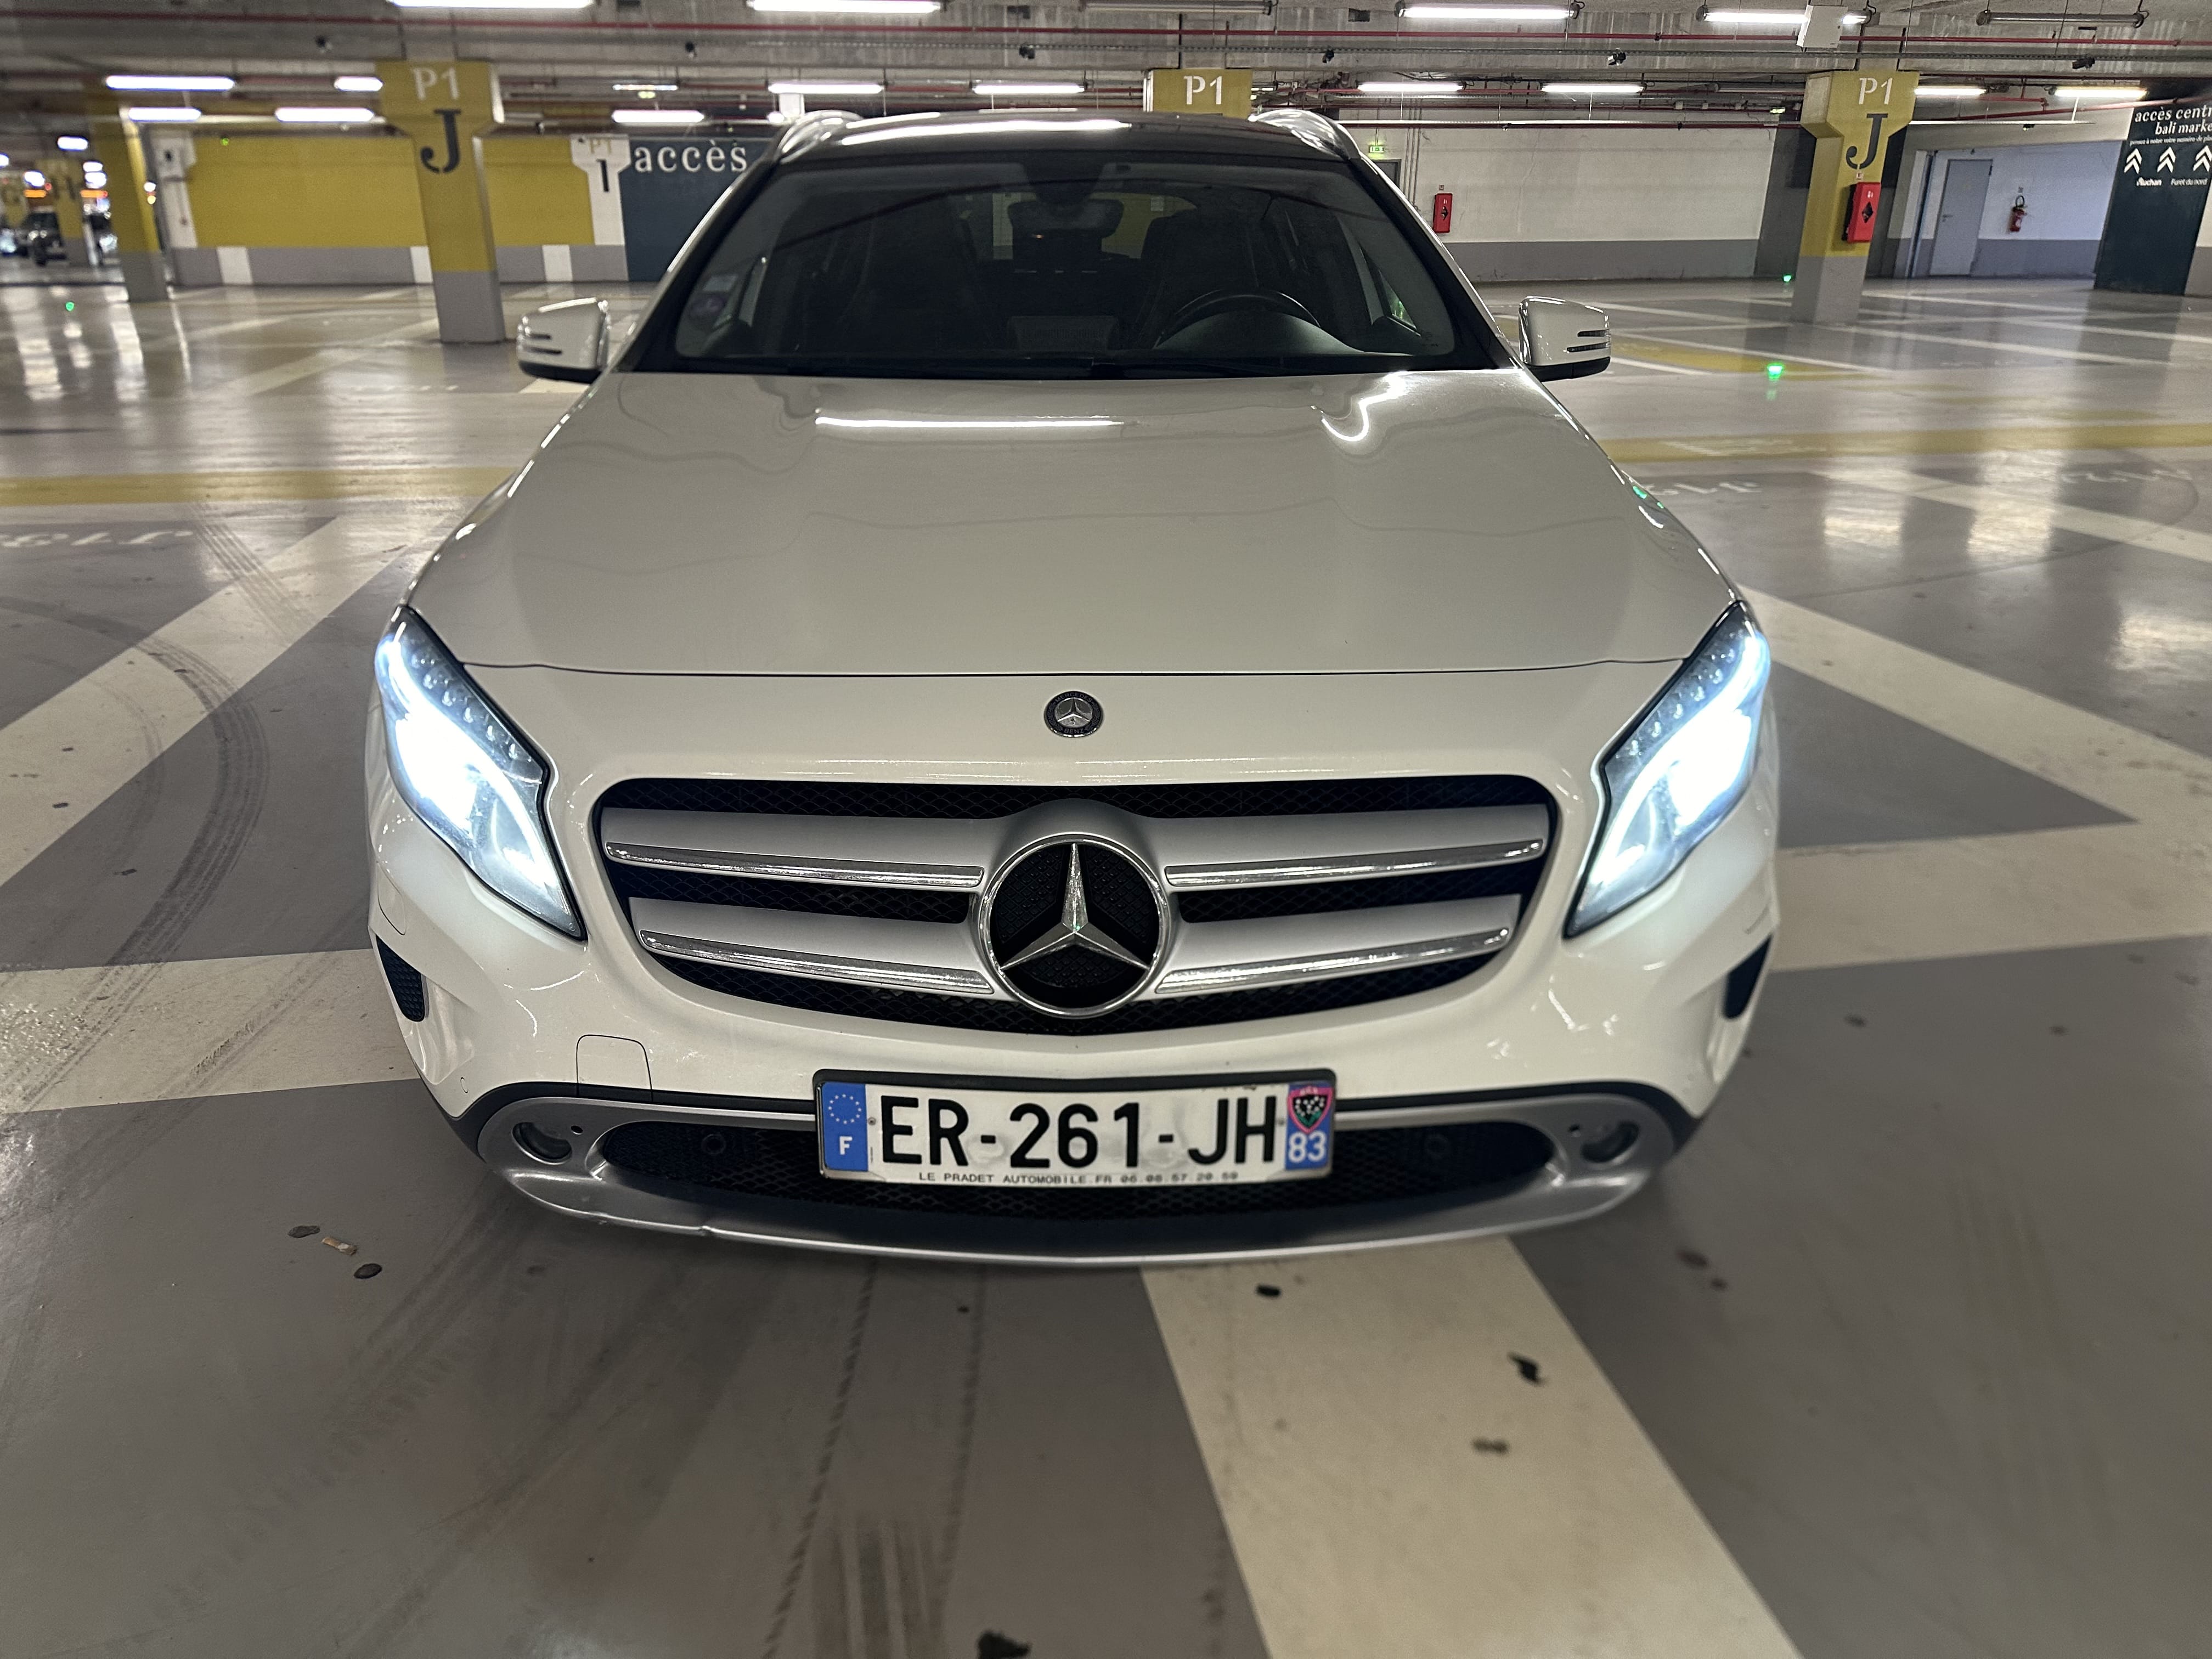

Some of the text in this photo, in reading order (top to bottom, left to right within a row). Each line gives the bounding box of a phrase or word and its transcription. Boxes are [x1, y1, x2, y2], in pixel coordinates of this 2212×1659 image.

[413, 66, 459, 100] P1
[1183, 75, 1223, 105] P1
[1858, 77, 1893, 105] P1
[2135, 106, 2172, 122] accès
[2155, 121, 2177, 135] bali
[420, 109, 461, 173] J
[634, 139, 748, 173] accès
[1846, 113, 1889, 170] J
[1054, 692, 1093, 703] MERCEDES
[839, 1136, 853, 1155] F
[881, 1095, 1277, 1168] ER-261-JH
[1289, 1131, 1327, 1163] 83
[918, 1172, 935, 1181] LE
[944, 1172, 995, 1183] PRADET
